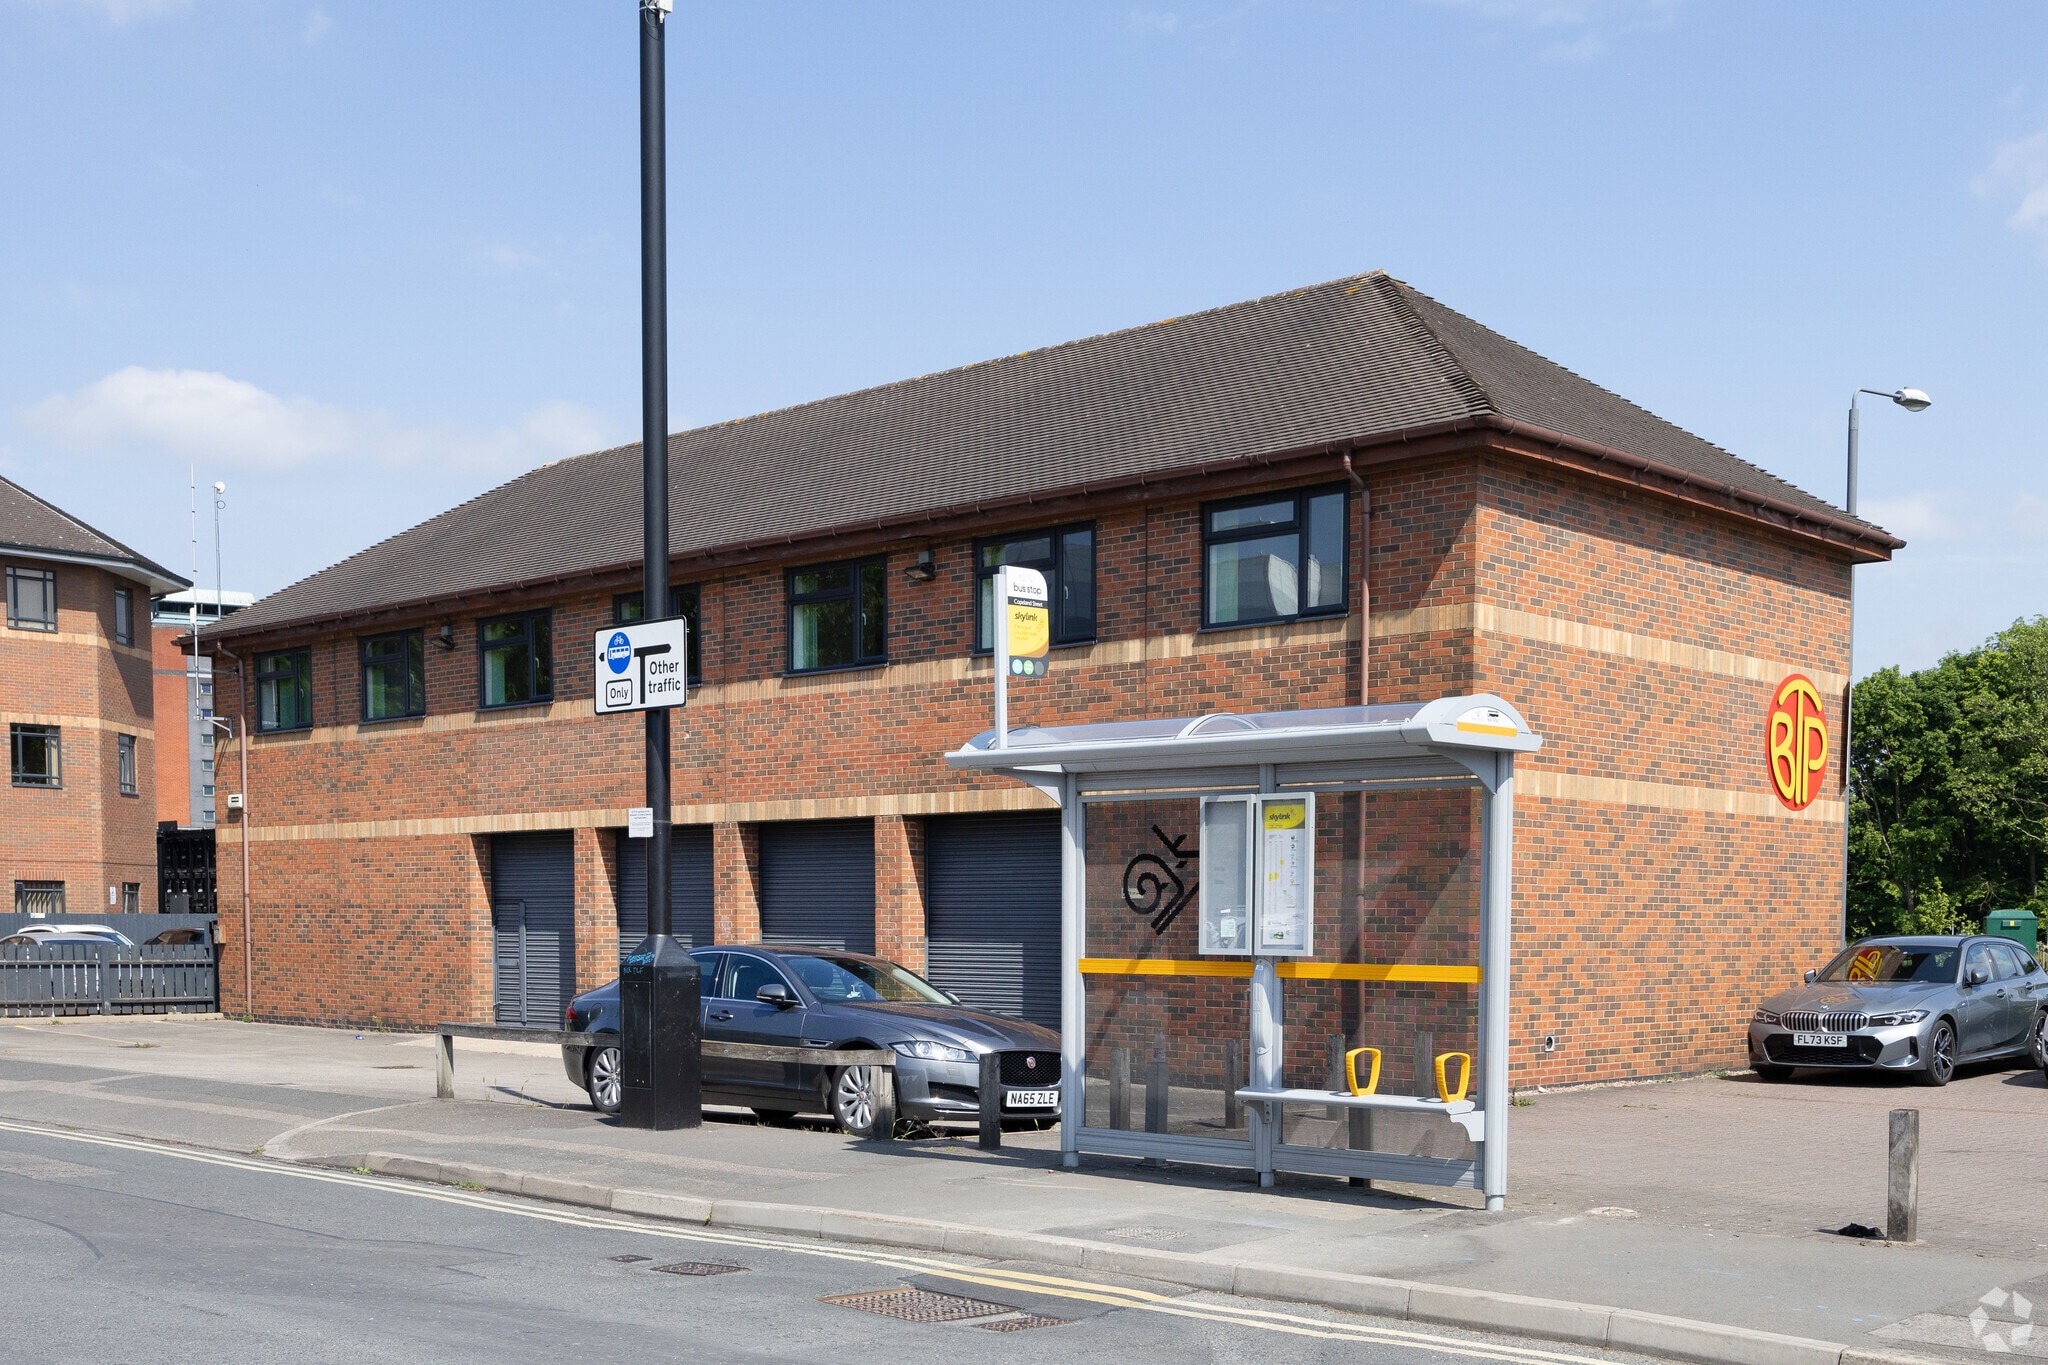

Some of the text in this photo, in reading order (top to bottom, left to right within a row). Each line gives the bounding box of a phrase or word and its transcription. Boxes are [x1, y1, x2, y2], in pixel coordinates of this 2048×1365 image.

[1013, 581, 1042, 597] bus stop
[1014, 611, 1038, 622] skylink
[649, 659, 680, 675] Other
[648, 677, 681, 694] traffic
[610, 687, 629, 700] Only
[1269, 813, 1291, 821] skylink
[1797, 1034, 1843, 1046] FL73 KSF
[1010, 1092, 1055, 1105] NA65 ZLE
